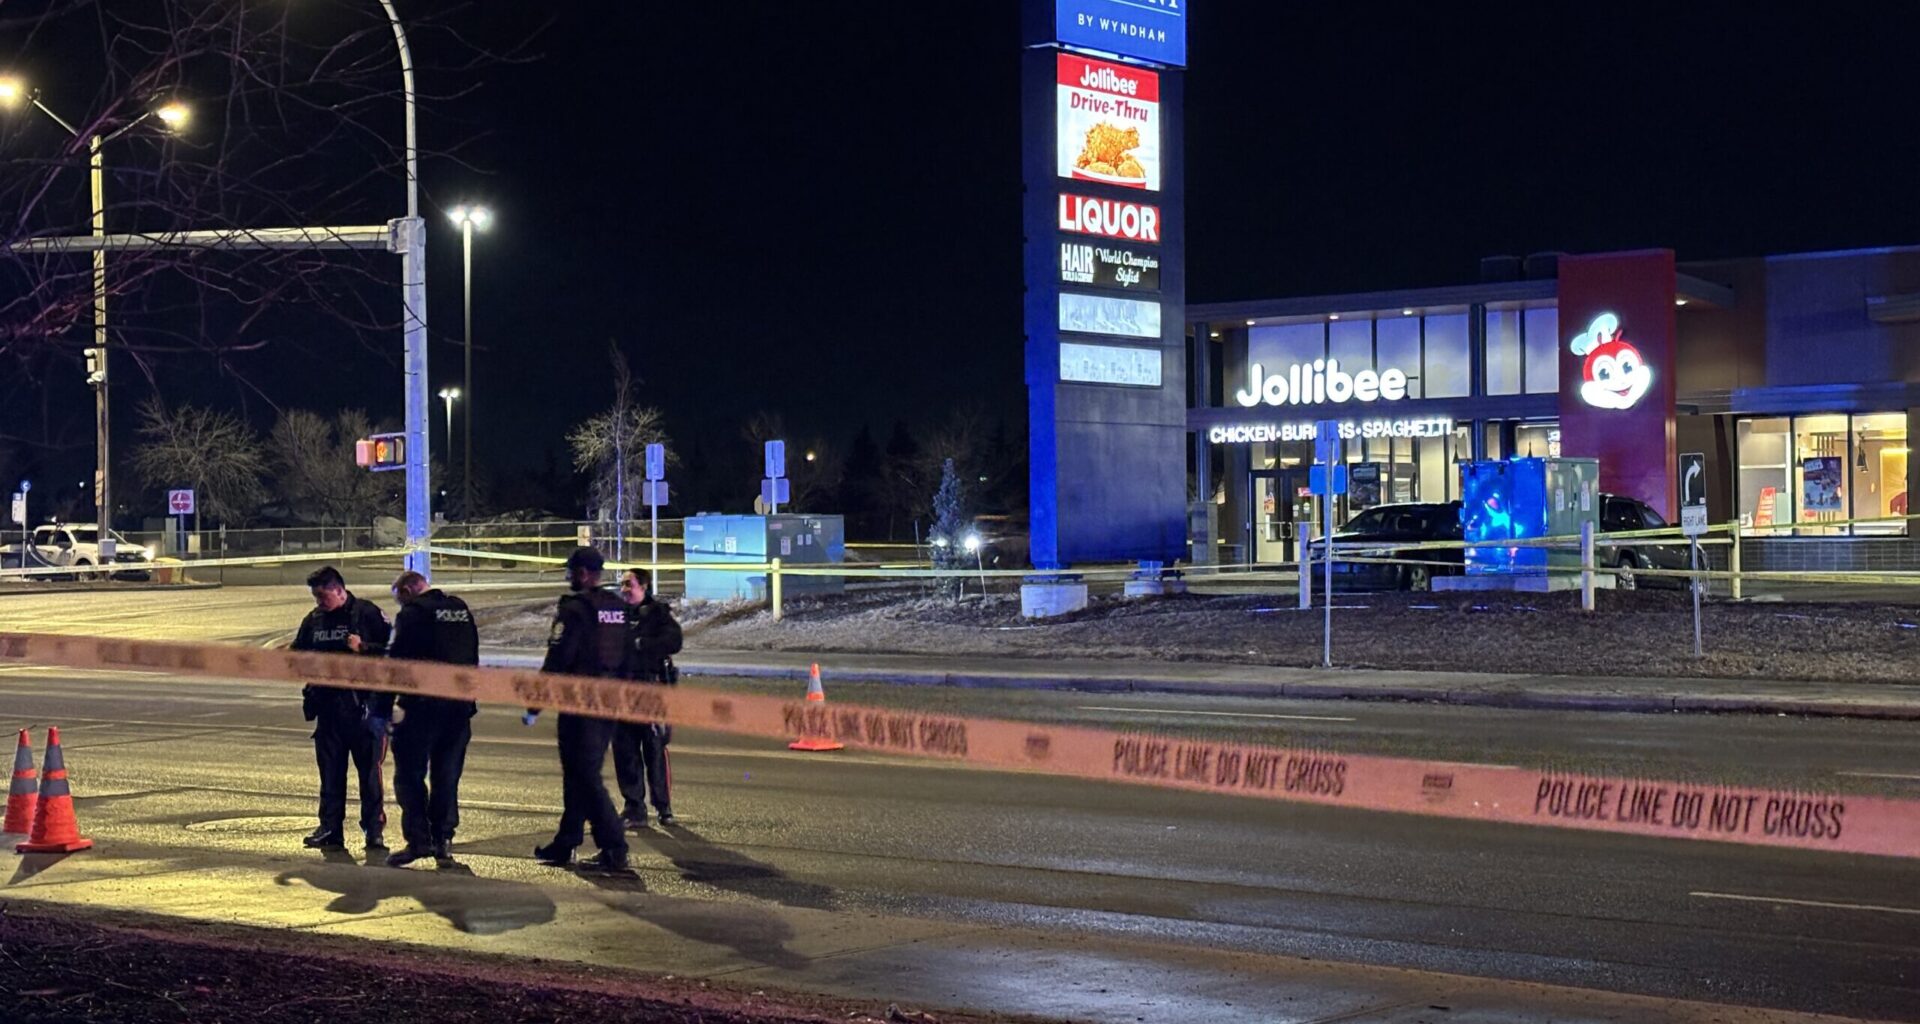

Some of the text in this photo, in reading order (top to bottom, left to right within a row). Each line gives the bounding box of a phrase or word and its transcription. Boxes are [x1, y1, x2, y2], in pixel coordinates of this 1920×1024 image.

[1078, 13, 1165, 42] BY WYNDHAM
[1080, 65, 1136, 95] Jollibee
[1071, 92, 1148, 122] Drive-Thru
[1059, 195, 1158, 241] LIQUOR
[1061, 243, 1094, 274] HAIR
[1095, 248, 1159, 273] World Champion
[1236, 358, 1408, 407] Jollibee
[1210, 418, 1452, 443] CHICKEN BURRS SPAGHETTI
[437, 609, 470, 622] POLICE
[598, 610, 625, 624] POLICE
[1114, 738, 1347, 797] POLICE LINE DO NOT CROSS
[1535, 777, 1844, 840] POLICE LINE DO NOT CROSS
